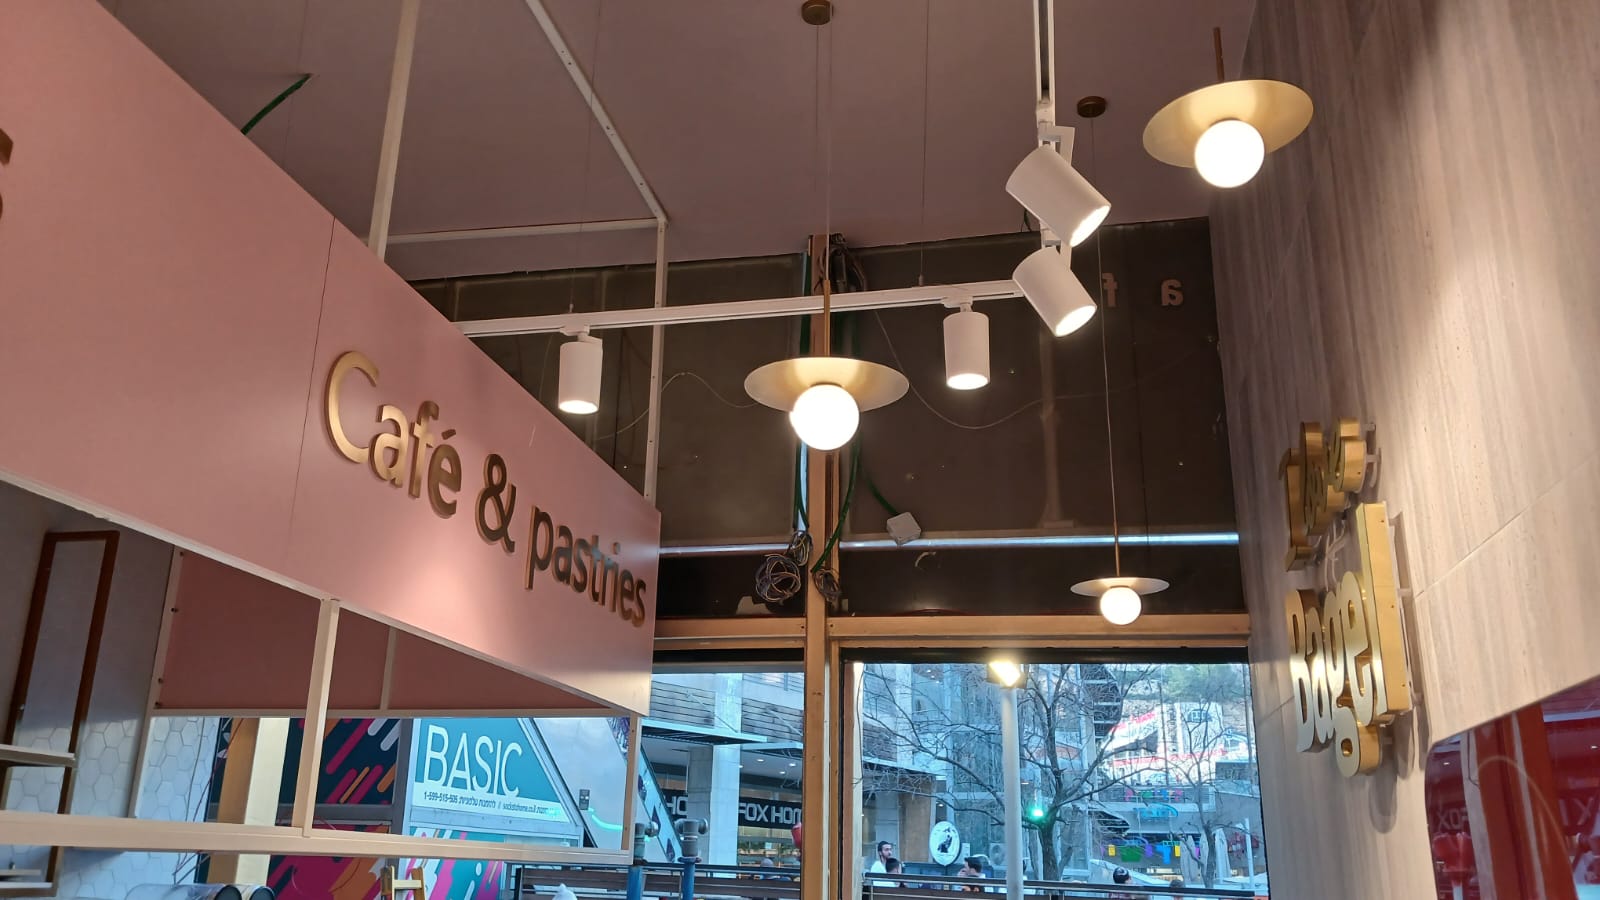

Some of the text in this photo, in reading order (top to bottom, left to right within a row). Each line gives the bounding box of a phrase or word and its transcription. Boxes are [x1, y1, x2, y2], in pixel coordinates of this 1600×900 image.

[324, 350, 647, 627] Café & pastries
[423, 724, 522, 797] BASIC
[1285, 501, 1411, 779] Bagel
